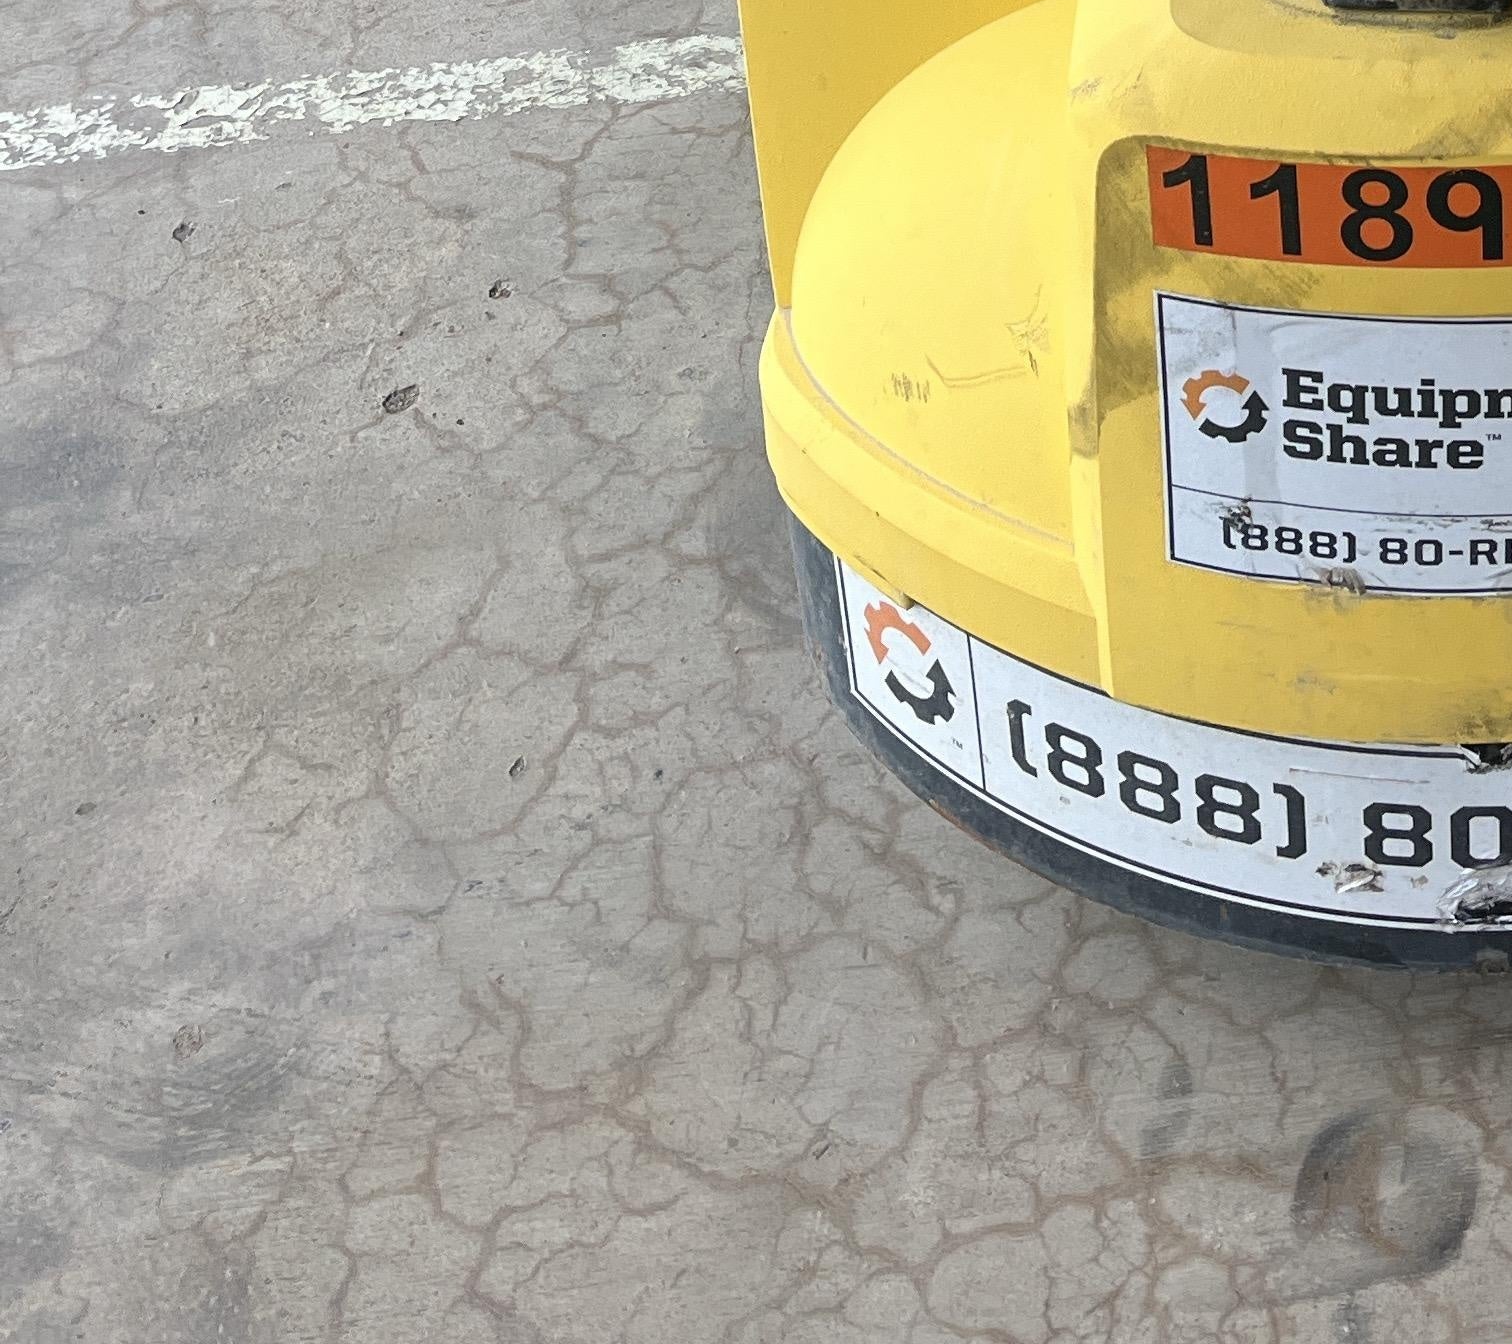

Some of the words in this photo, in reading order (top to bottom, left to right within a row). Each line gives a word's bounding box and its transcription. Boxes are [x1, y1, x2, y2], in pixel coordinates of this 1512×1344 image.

[1283, 418, 1484, 469] Share
[1222, 516, 1357, 562] (888)
[1004, 698, 1307, 859] (888)
